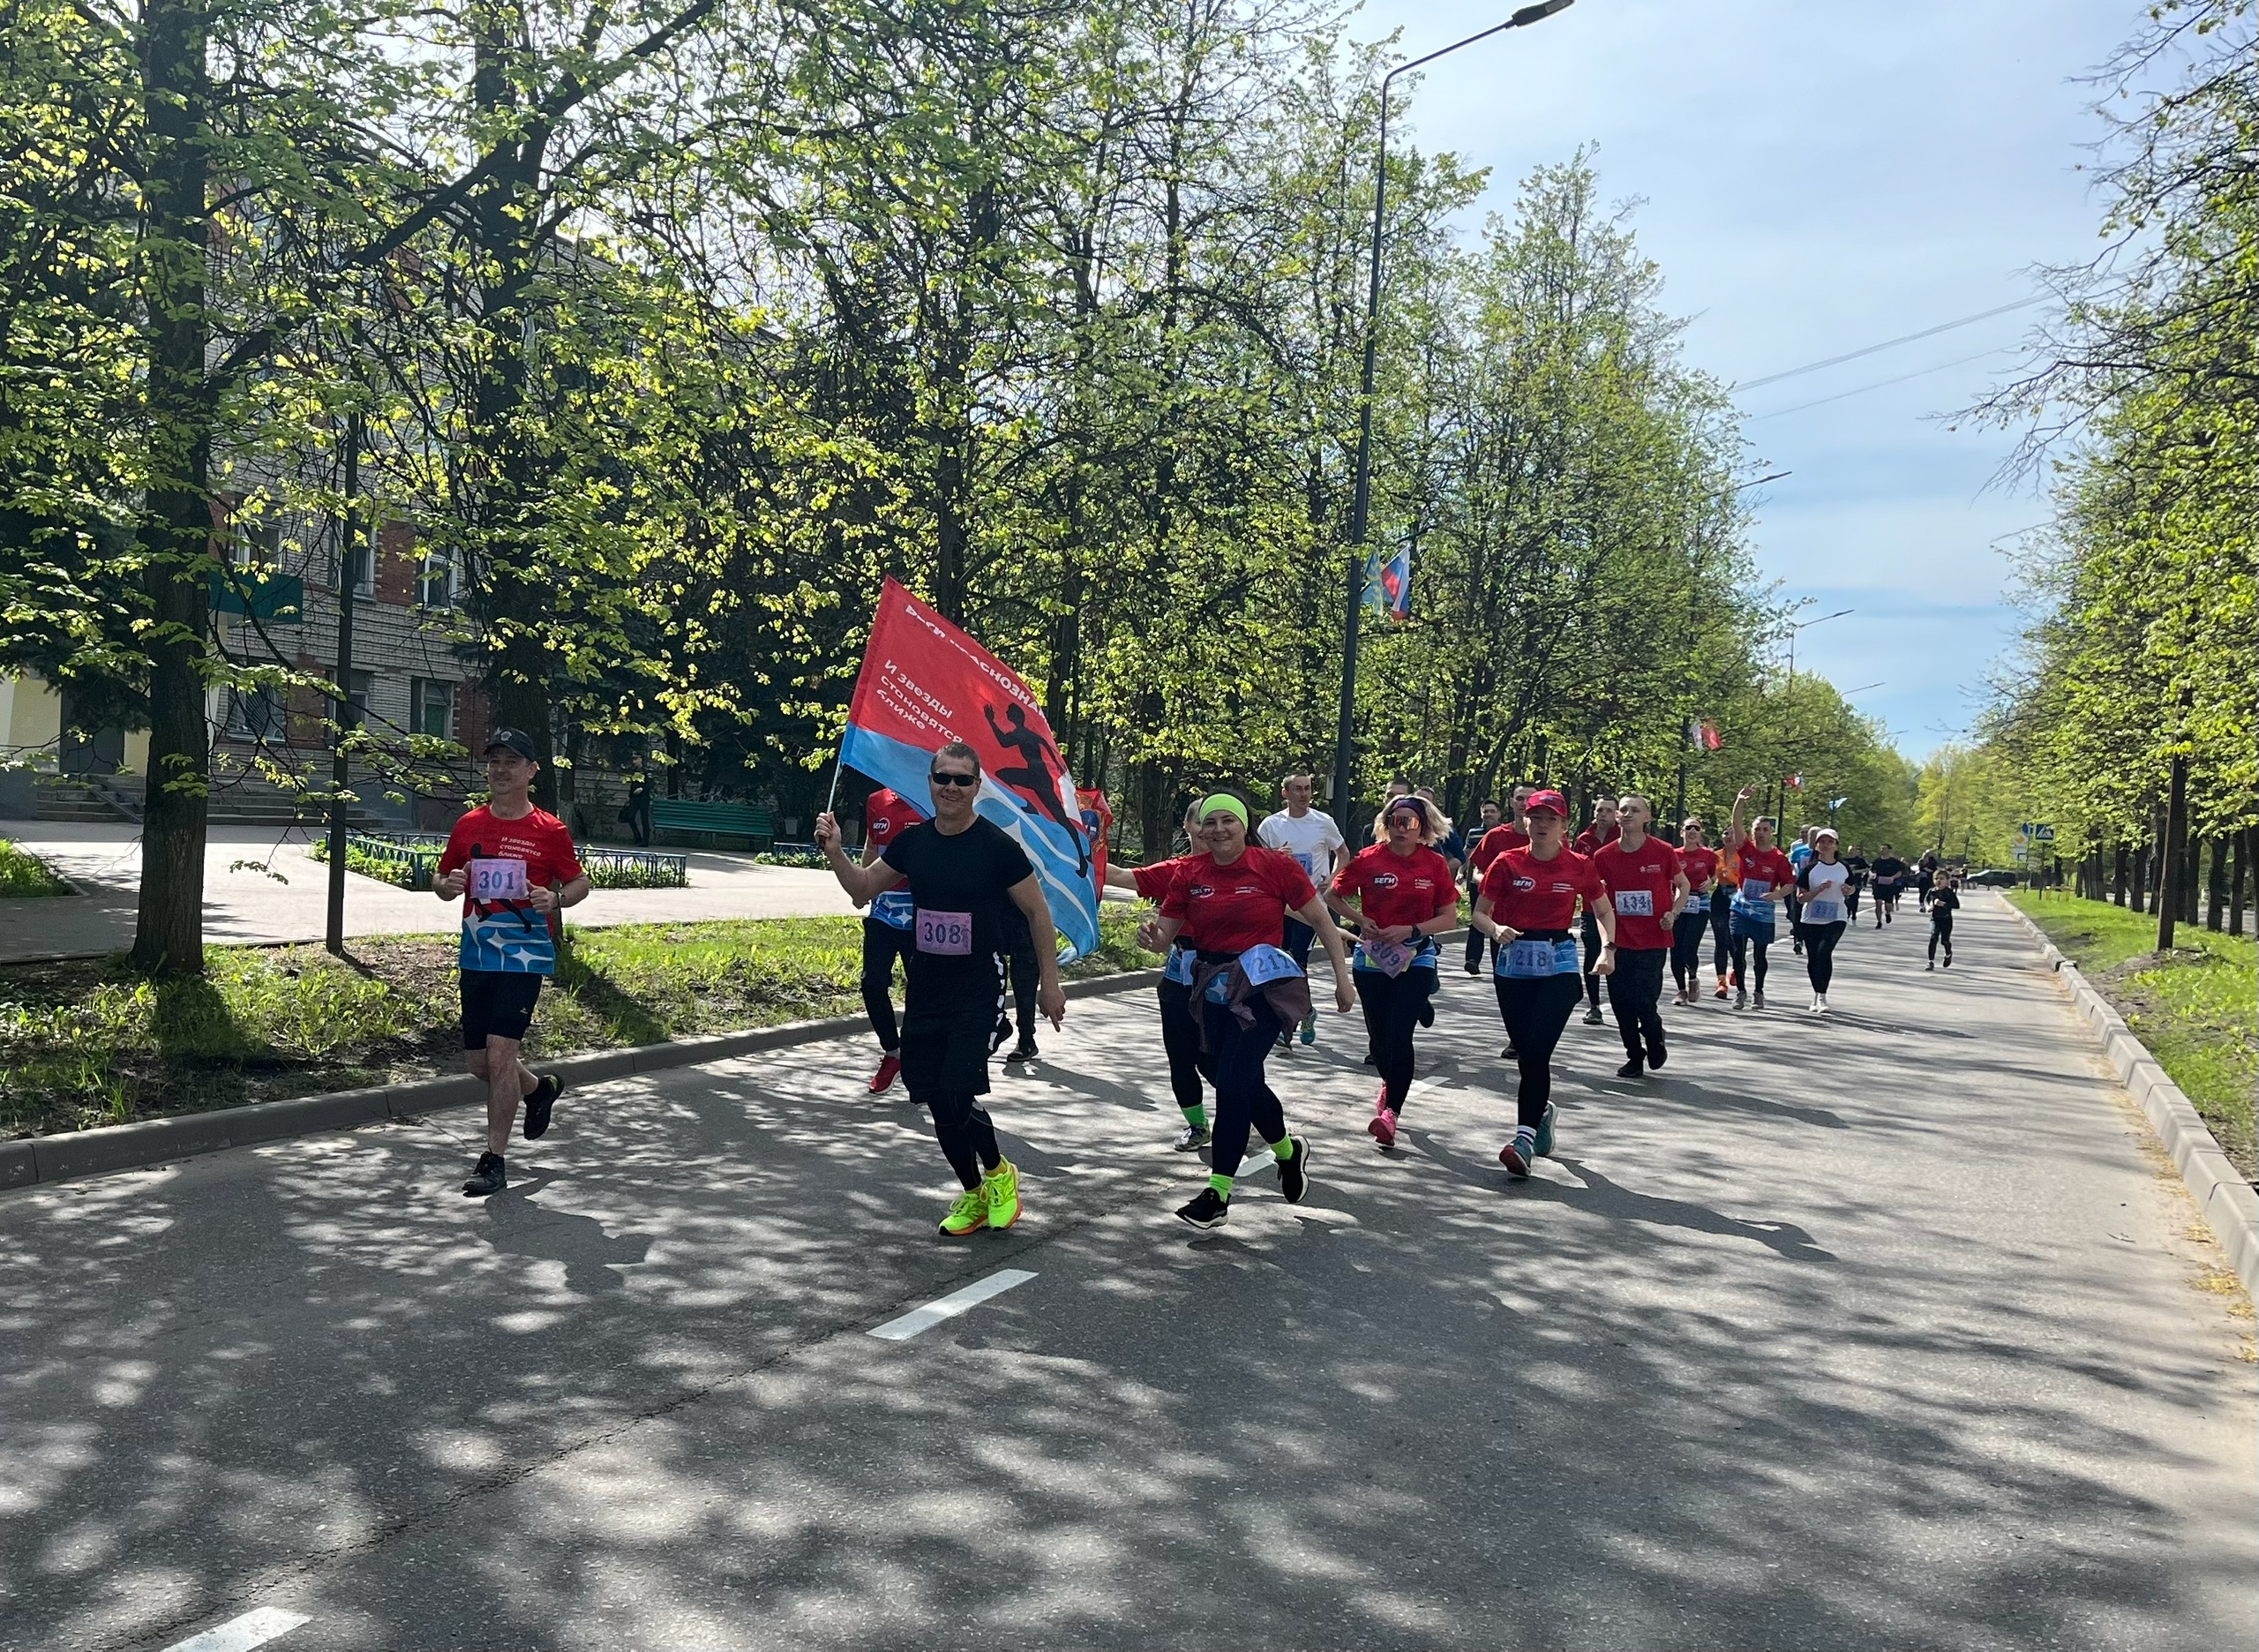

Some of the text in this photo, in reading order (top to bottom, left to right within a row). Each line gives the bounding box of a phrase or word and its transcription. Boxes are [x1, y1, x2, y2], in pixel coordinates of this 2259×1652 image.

[884, 659, 953, 719] И звезды
[876, 688, 926, 730] ближе
[881, 675, 964, 744] становятся
[479, 870, 514, 890] 301
[924, 921, 962, 945] 308
[1253, 954, 1291, 975] 217
[1516, 950, 1548, 968] 218
